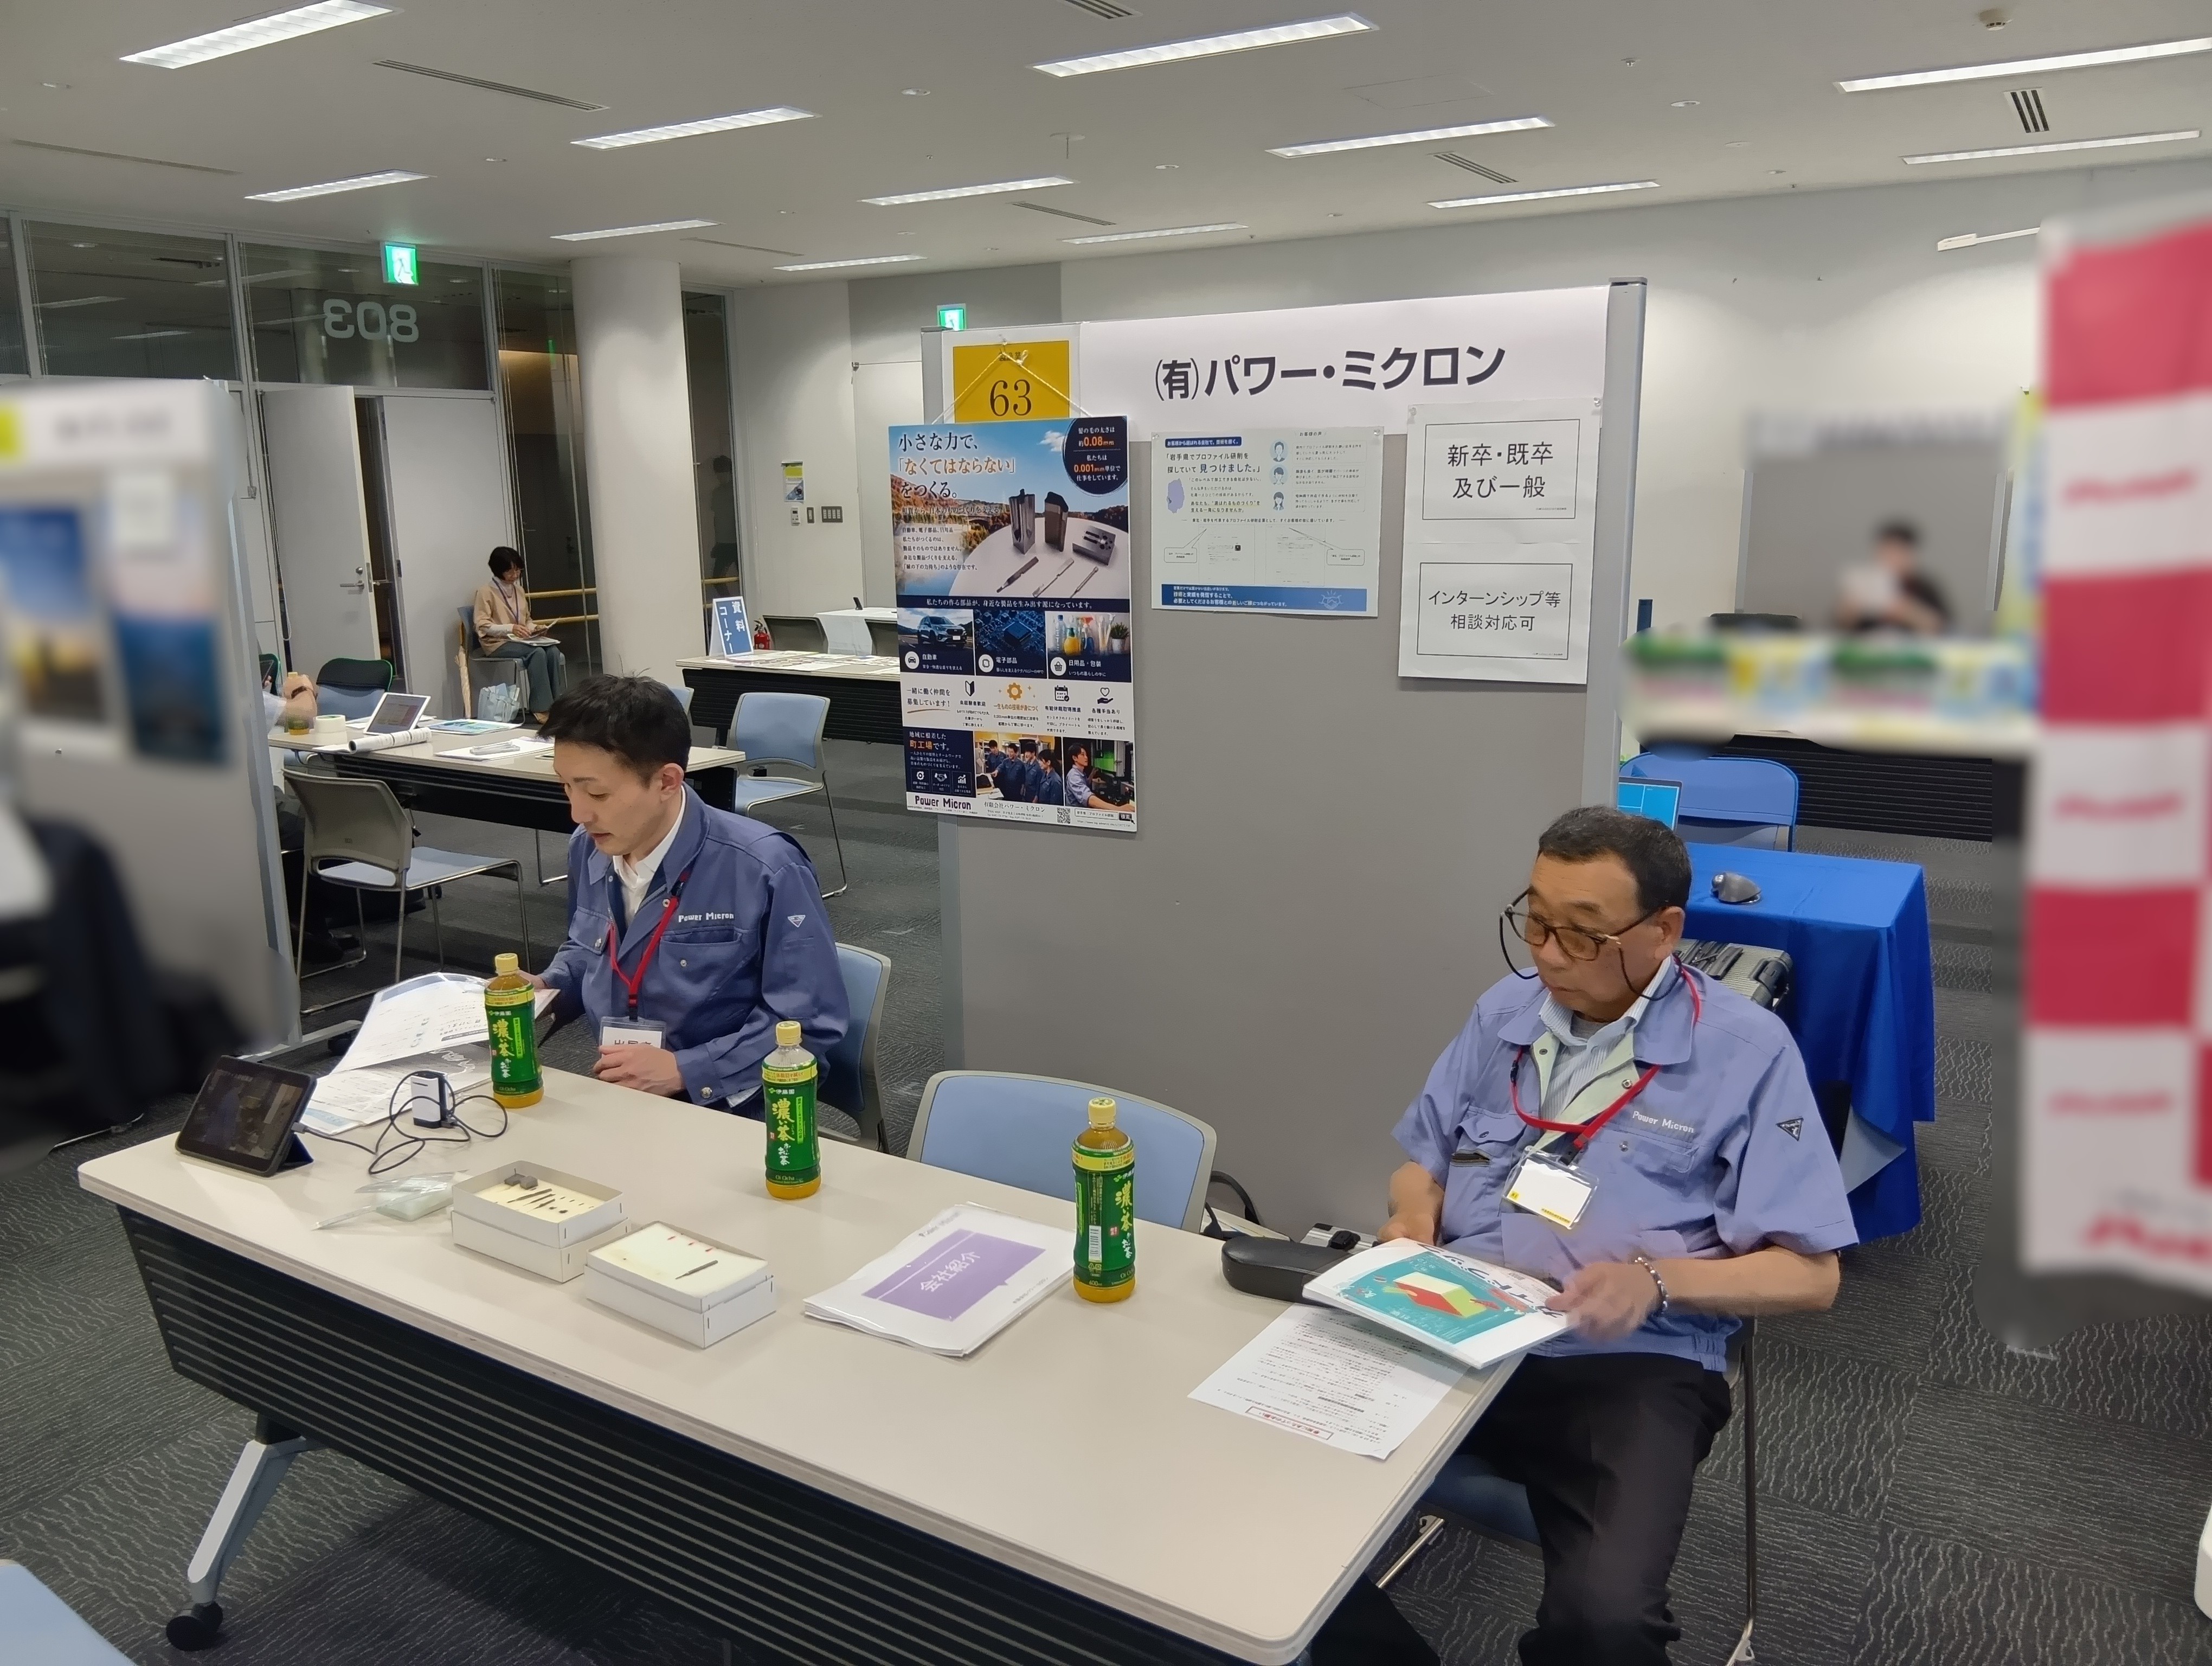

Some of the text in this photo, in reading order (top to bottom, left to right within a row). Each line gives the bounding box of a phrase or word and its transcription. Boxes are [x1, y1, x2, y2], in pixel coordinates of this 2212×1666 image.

[1155, 346, 1505, 401] (有)パワー・ミクロン
[990, 379, 1032, 416] 63
[898, 432, 978, 452] 小さな力で、
[1078, 436, 1114, 447] 約0.08mm
[1166, 452, 1249, 460] 「岩手県でプロファイル研削を
[1448, 441, 1554, 467] 新卒・既卒
[899, 457, 1015, 476] 「なくてはならない」
[1074, 464, 1121, 472] 0.001mm単位で
[1200, 464, 1261, 473] 見つけました。」
[901, 481, 957, 498] をつくる。
[1452, 475, 1546, 498] 及び一般
[1429, 590, 1561, 608] インターンシップ等
[731, 601, 745, 632] 資料
[1451, 613, 1535, 631] 相談対応可
[719, 606, 733, 653] コーナー
[906, 687, 950, 696] 一緒に働く仲間を
[910, 740, 950, 751] 町工場です。
[915, 796, 972, 810] Power Micron
[984, 801, 1046, 812] 有限会社パワー・ミクロン
[678, 914, 702, 922] Power
[492, 1018, 515, 1056] 濃い茶
[771, 1098, 795, 1140] 濃い茶
[1632, 1111, 1695, 1133] Power Micron
[1115, 1180, 1133, 1231] 濃い茶
[921, 1252, 981, 1292] 会社紹介
[1417, 1243, 1563, 1318] ガイドブック
